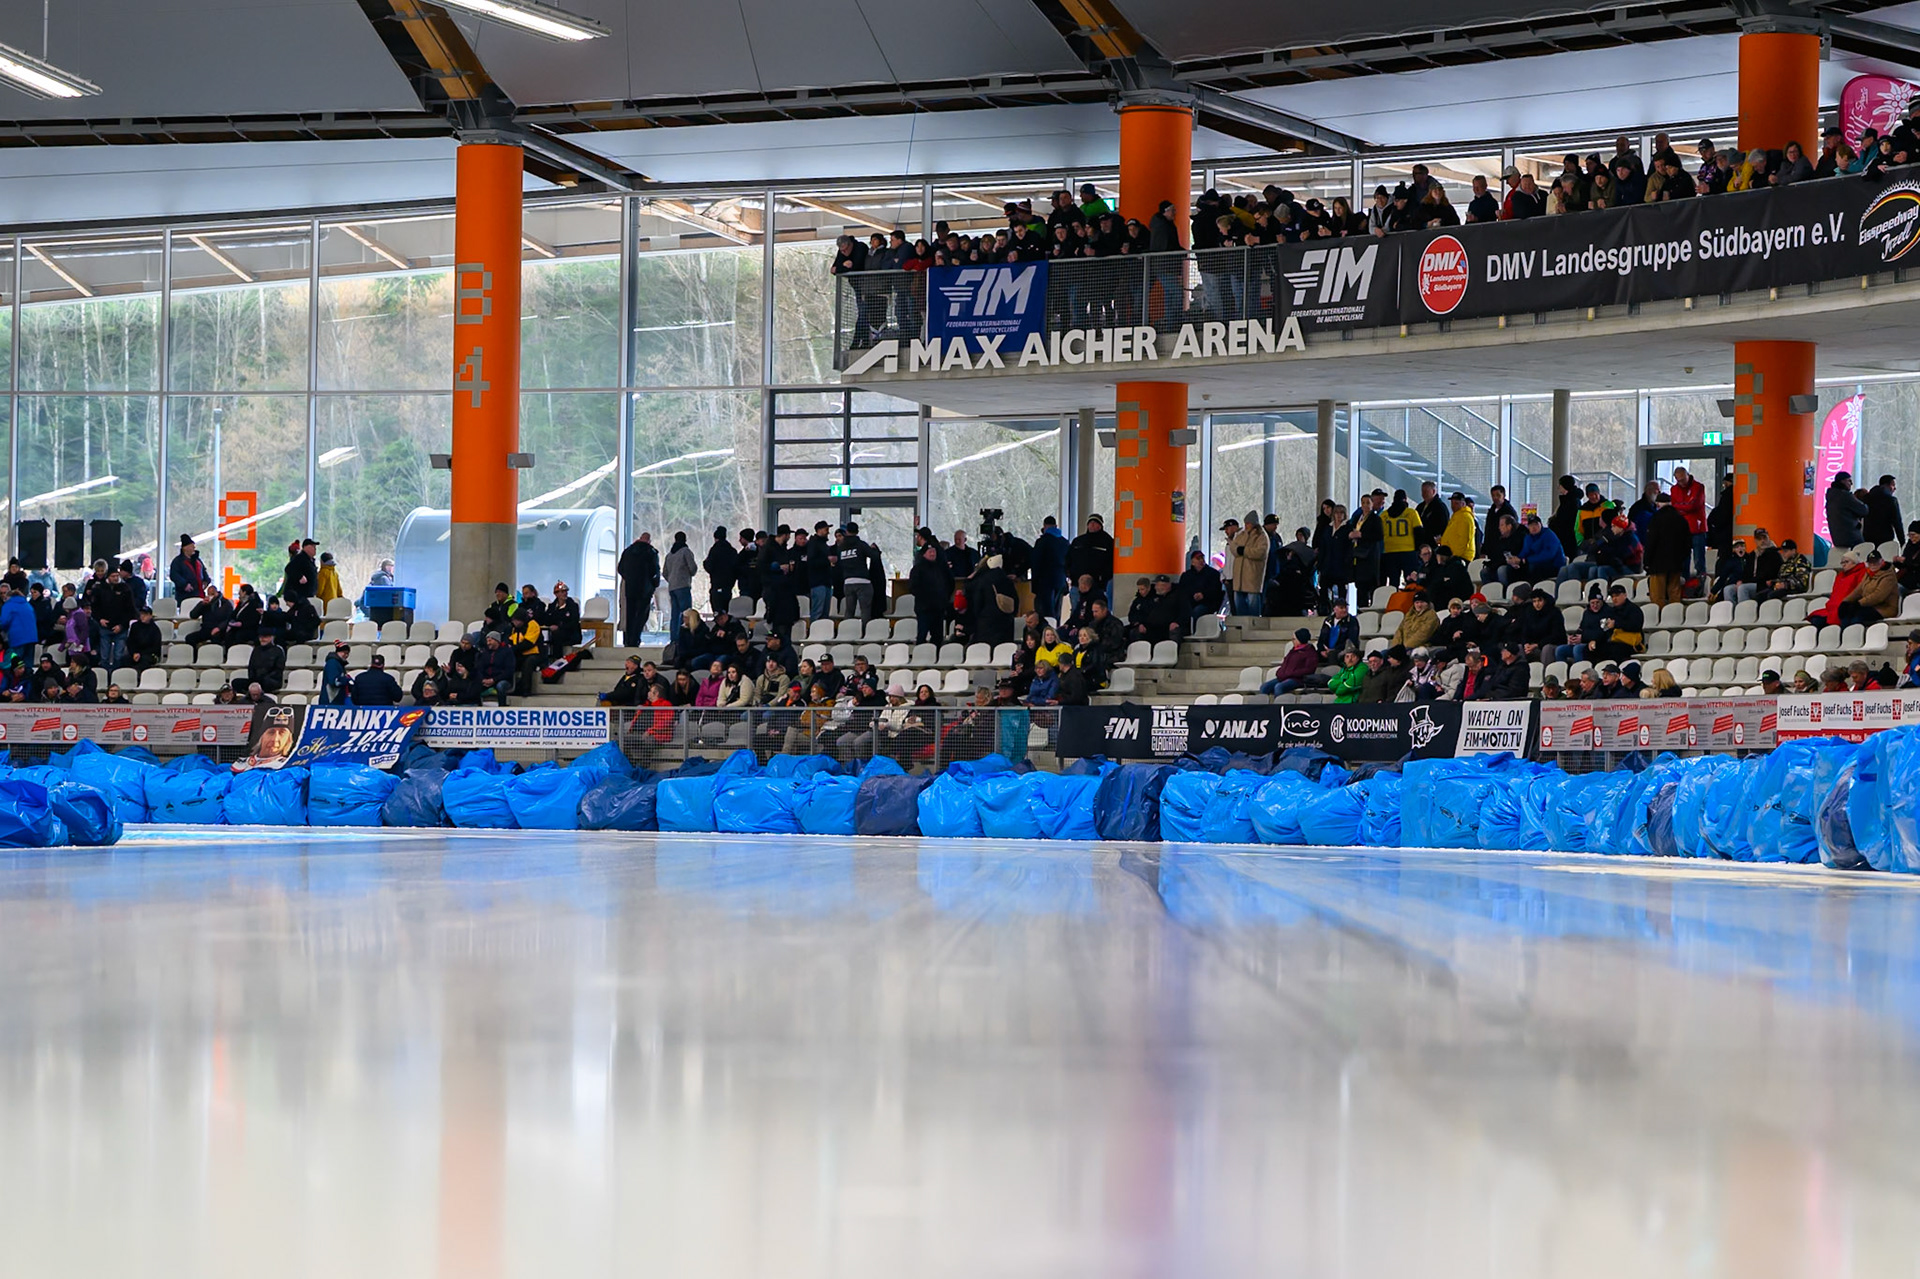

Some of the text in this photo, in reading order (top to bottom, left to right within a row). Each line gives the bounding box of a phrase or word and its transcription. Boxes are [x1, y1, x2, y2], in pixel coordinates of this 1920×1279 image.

[1859, 204, 1919, 246] Eisspeedway
[1487, 212, 1845, 282] DMV Landesgruppe Südbayern e.V.
[1423, 251, 1462, 272] DMV
[1283, 244, 1378, 305] FIM
[1430, 274, 1467, 282] Landesgruppe
[456, 263, 492, 324] B
[939, 266, 1037, 316] FIM
[1321, 306, 1365, 315] INTERNATIONALE
[1324, 313, 1364, 322] MOTOCYCLISME
[909, 317, 1305, 372] MAX AICHER ARENA
[455, 347, 490, 408] 4
[1386, 519, 1409, 537] 10
[1793, 706, 1809, 716] Fuchs
[1836, 704, 1852, 715] Fuchs
[1877, 702, 1892, 714] Fuchs
[310, 708, 399, 731] FRANKY
[425, 710, 473, 726] OSER
[476, 710, 541, 726] MOSER
[542, 710, 606, 726] MOSER
[1152, 710, 1189, 728] ICE
[1280, 705, 1320, 737] Kineo
[1346, 718, 1398, 732] KOOPMANN
[1468, 709, 1523, 726] WATCH ON
[341, 726, 411, 748] ZORN
[418, 728, 473, 737] UMASCHINEN
[476, 728, 540, 737] BAUMASCHINEN
[543, 728, 606, 737] BAUMASCHINEN
[1104, 718, 1140, 740] FIM
[1219, 720, 1270, 739] ANLAS
[1151, 736, 1188, 751] GLADIATORS
